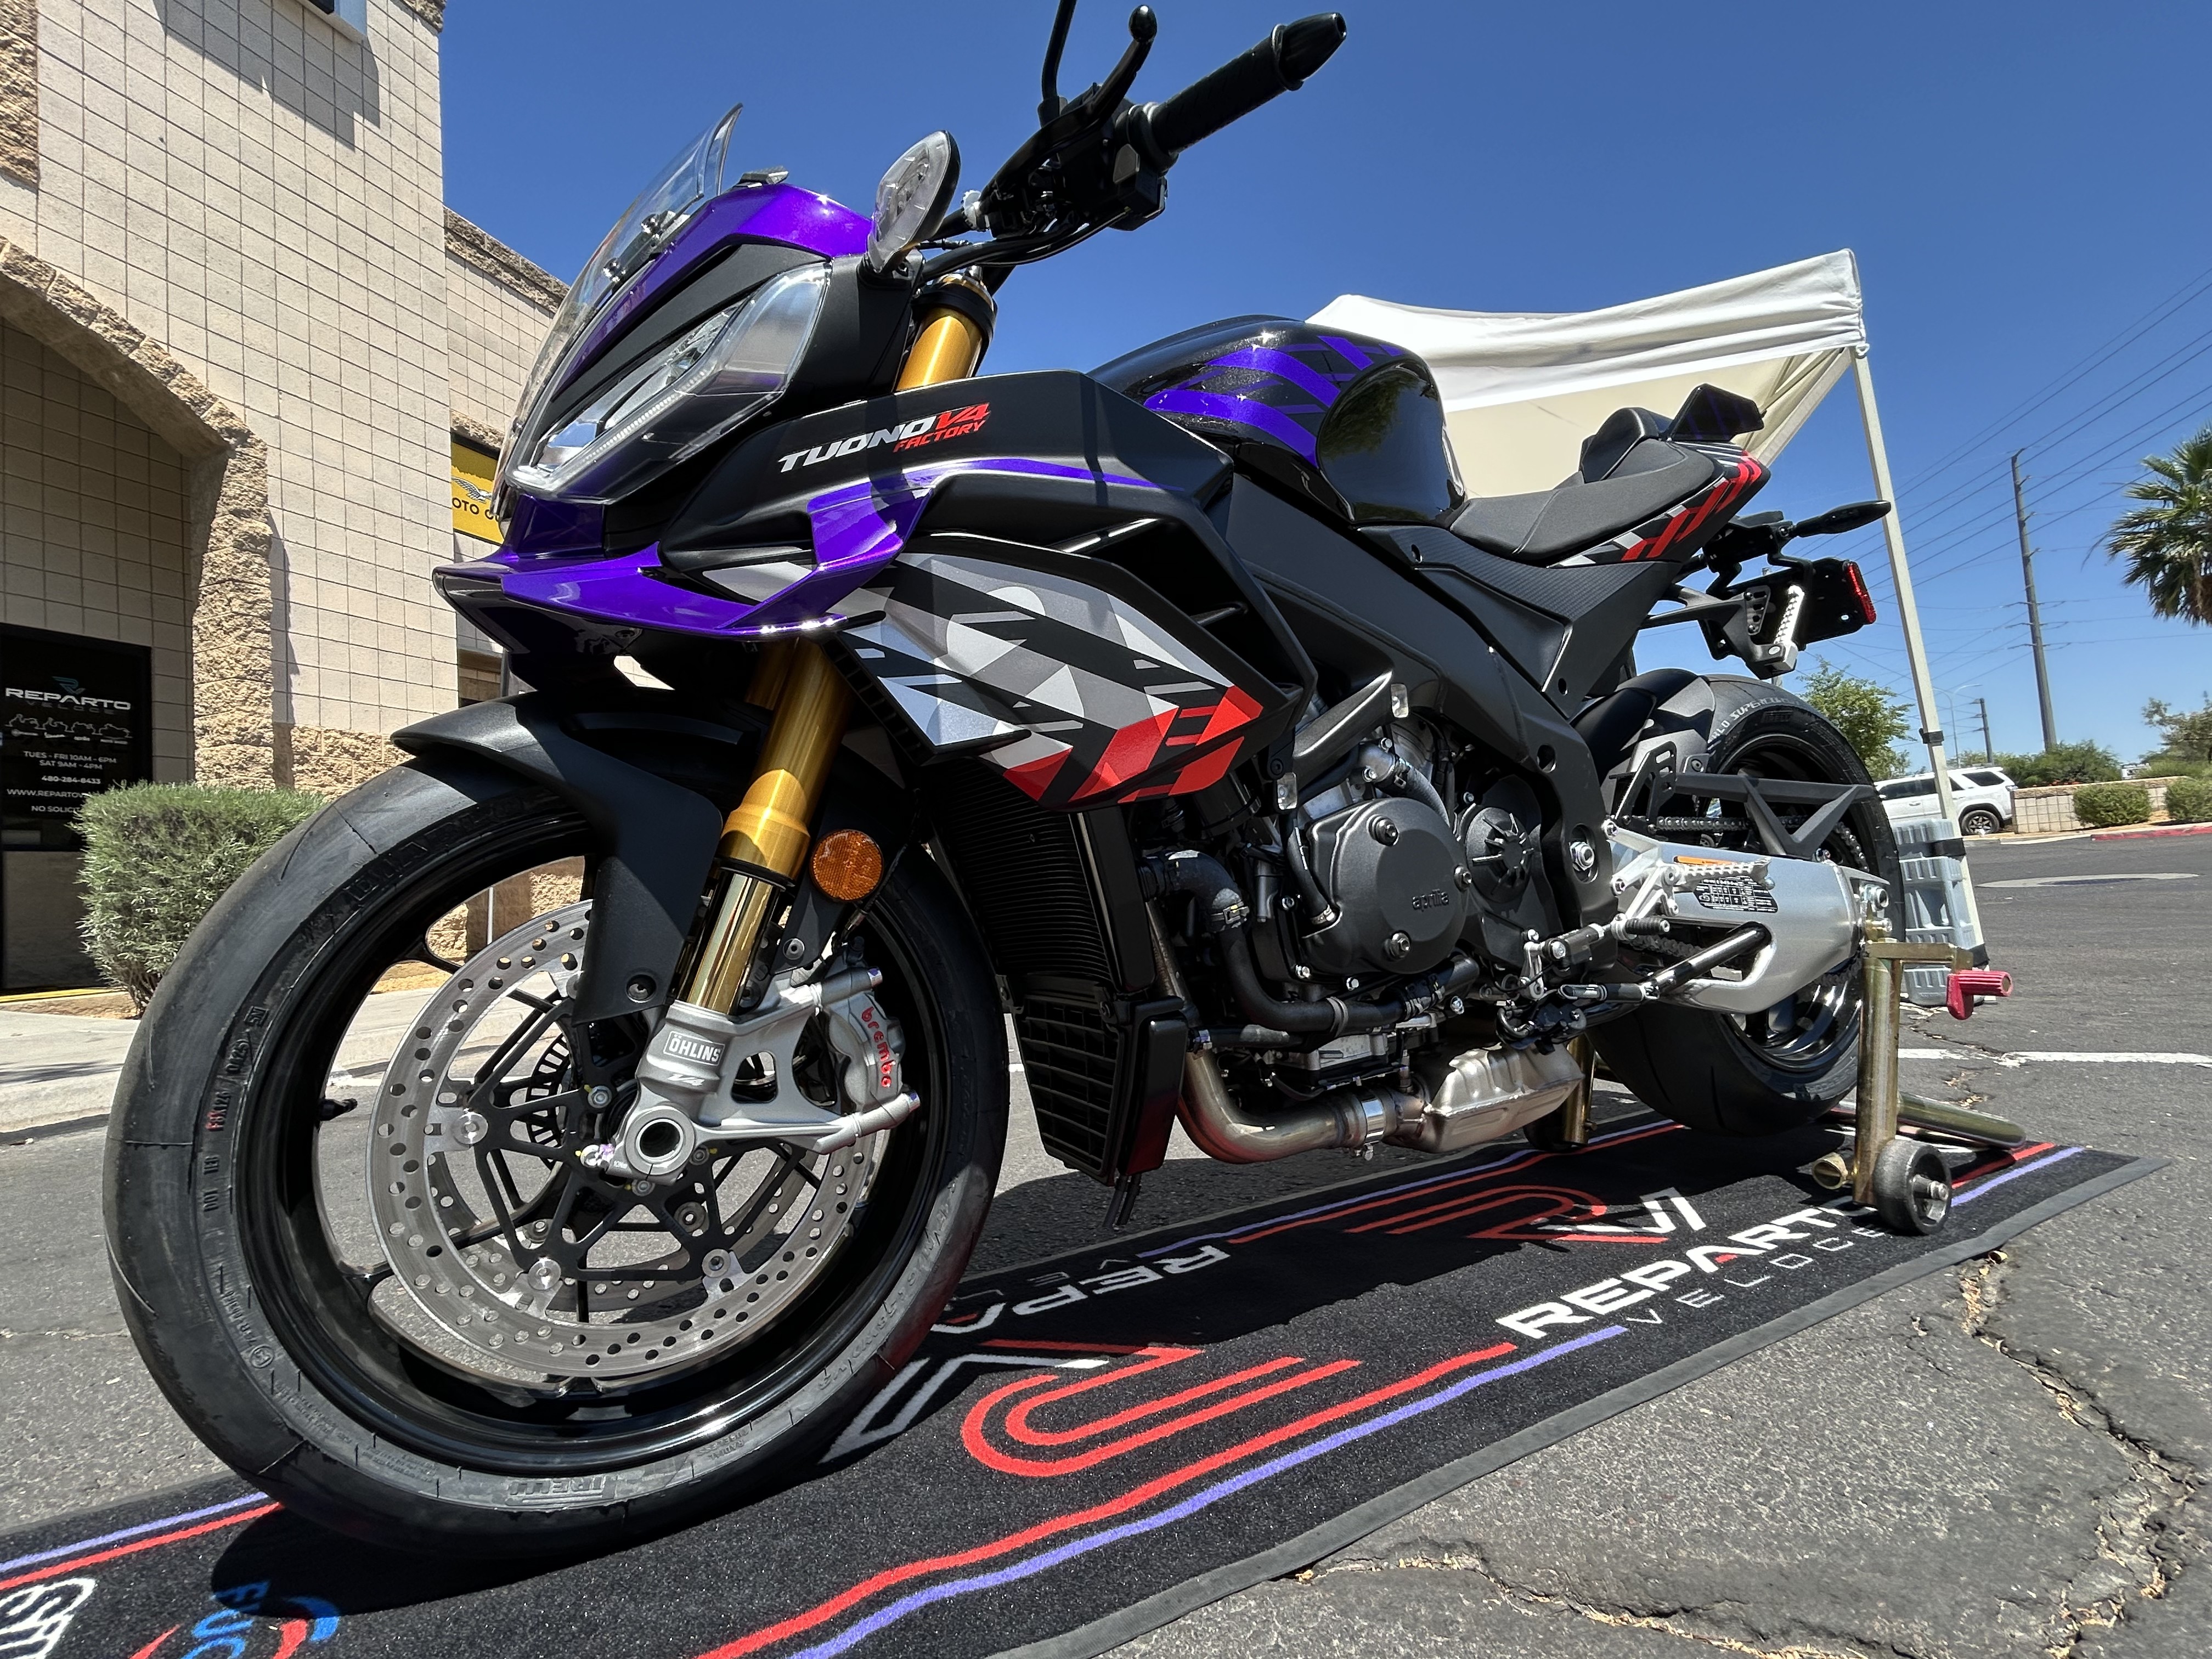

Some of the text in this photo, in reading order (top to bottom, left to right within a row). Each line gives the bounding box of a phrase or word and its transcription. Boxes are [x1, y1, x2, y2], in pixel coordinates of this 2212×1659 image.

[778, 402, 990, 472] TUONO V4
[893, 420, 986, 453] FACTORY
[452, 497, 479, 515] OTO
[5, 687, 131, 710] REPARTO
[26, 699, 115, 715] VELOCE
[23, 751, 47, 759] TUES
[7, 788, 86, 798] WWW.REPARTOV
[1412, 888, 1449, 912] aprilia
[669, 1033, 723, 1063] ÖHLINS
[861, 1006, 896, 1088] brembo
